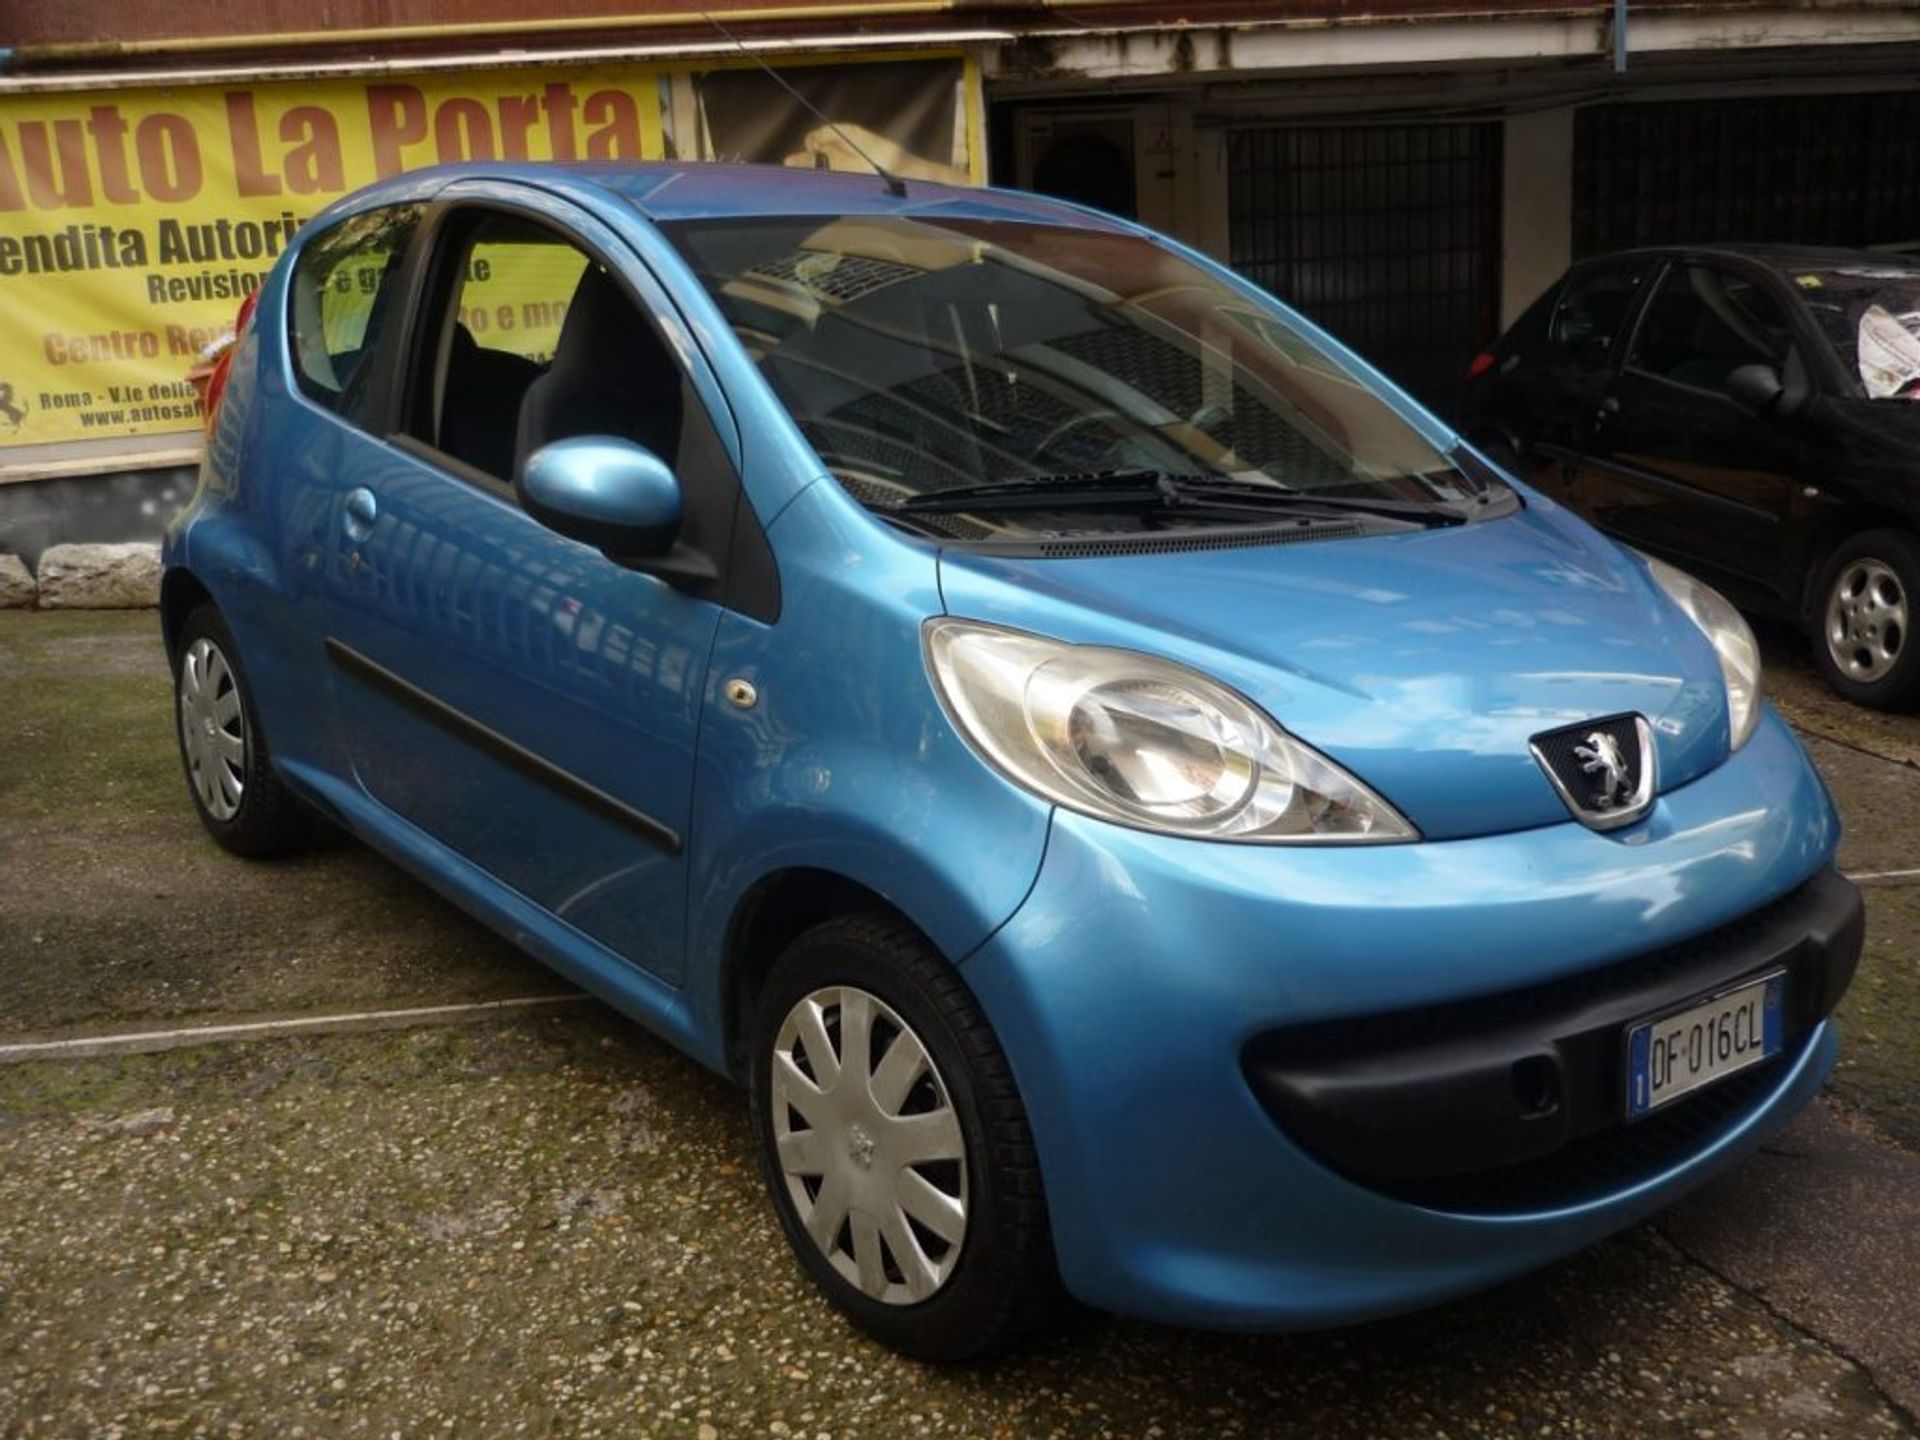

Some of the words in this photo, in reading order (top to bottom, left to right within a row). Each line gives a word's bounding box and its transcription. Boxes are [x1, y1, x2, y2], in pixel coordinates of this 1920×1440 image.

[225, 90, 346, 197] La
[366, 82, 642, 181] Porta
[159, 212, 306, 265] Autori
[147, 268, 267, 303] Revisio
[43, 330, 159, 366] Centro
[39, 390, 92, 409] Roma
[108, 385, 143, 404] V.le
